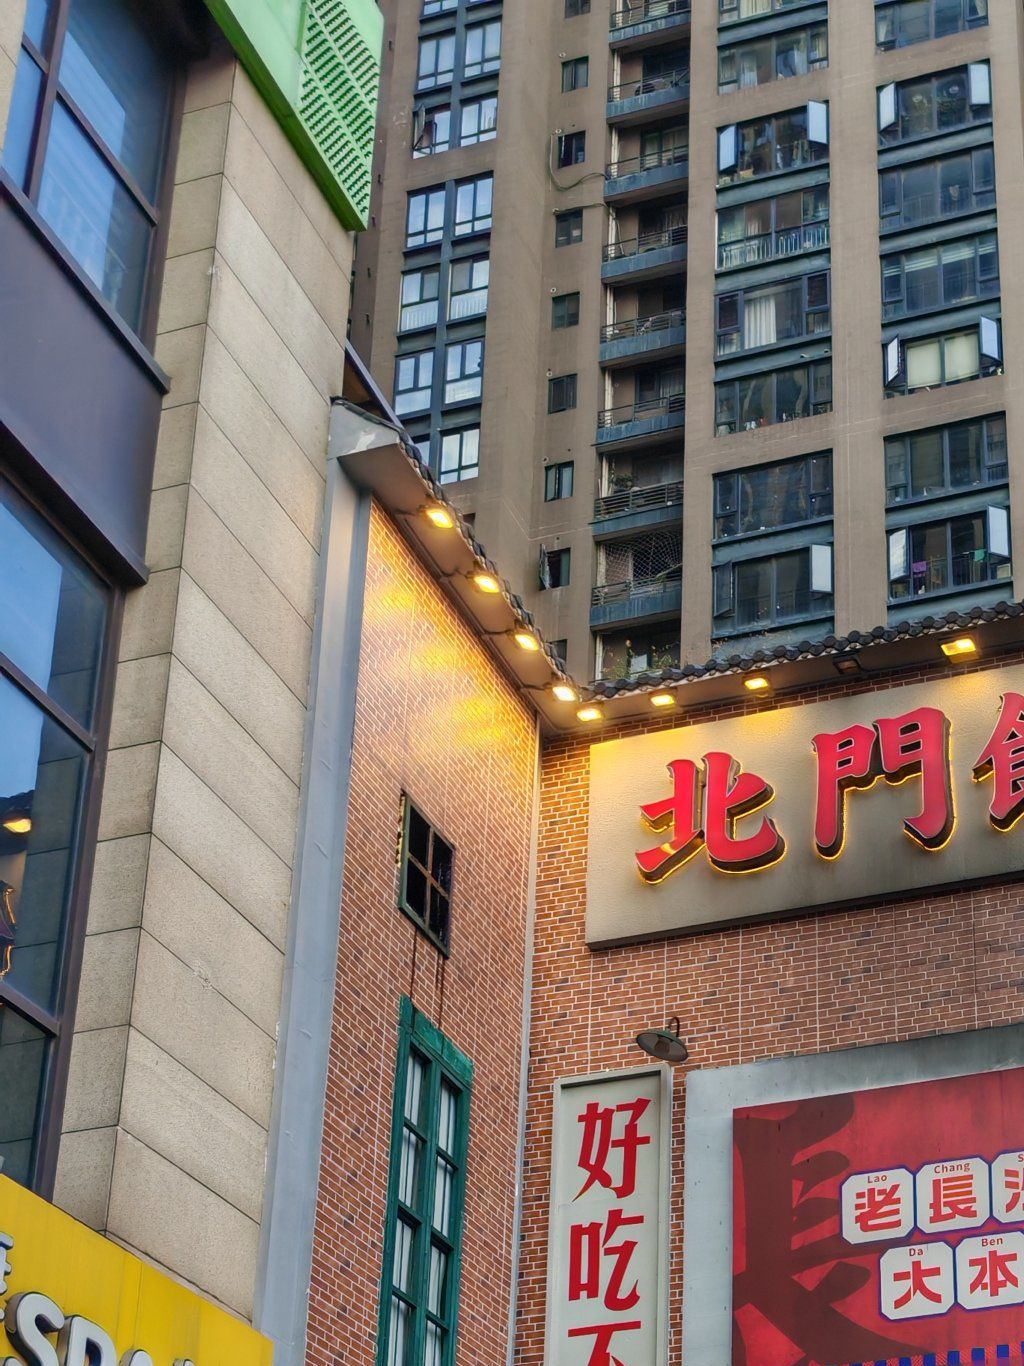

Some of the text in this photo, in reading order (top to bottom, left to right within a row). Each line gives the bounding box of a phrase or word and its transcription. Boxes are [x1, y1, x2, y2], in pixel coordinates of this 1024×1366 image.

[866, 1173, 888, 1184] Lao
[933, 1161, 971, 1175] Chang
[908, 1247, 924, 1258] Da
[981, 1236, 1004, 1248] Ben
